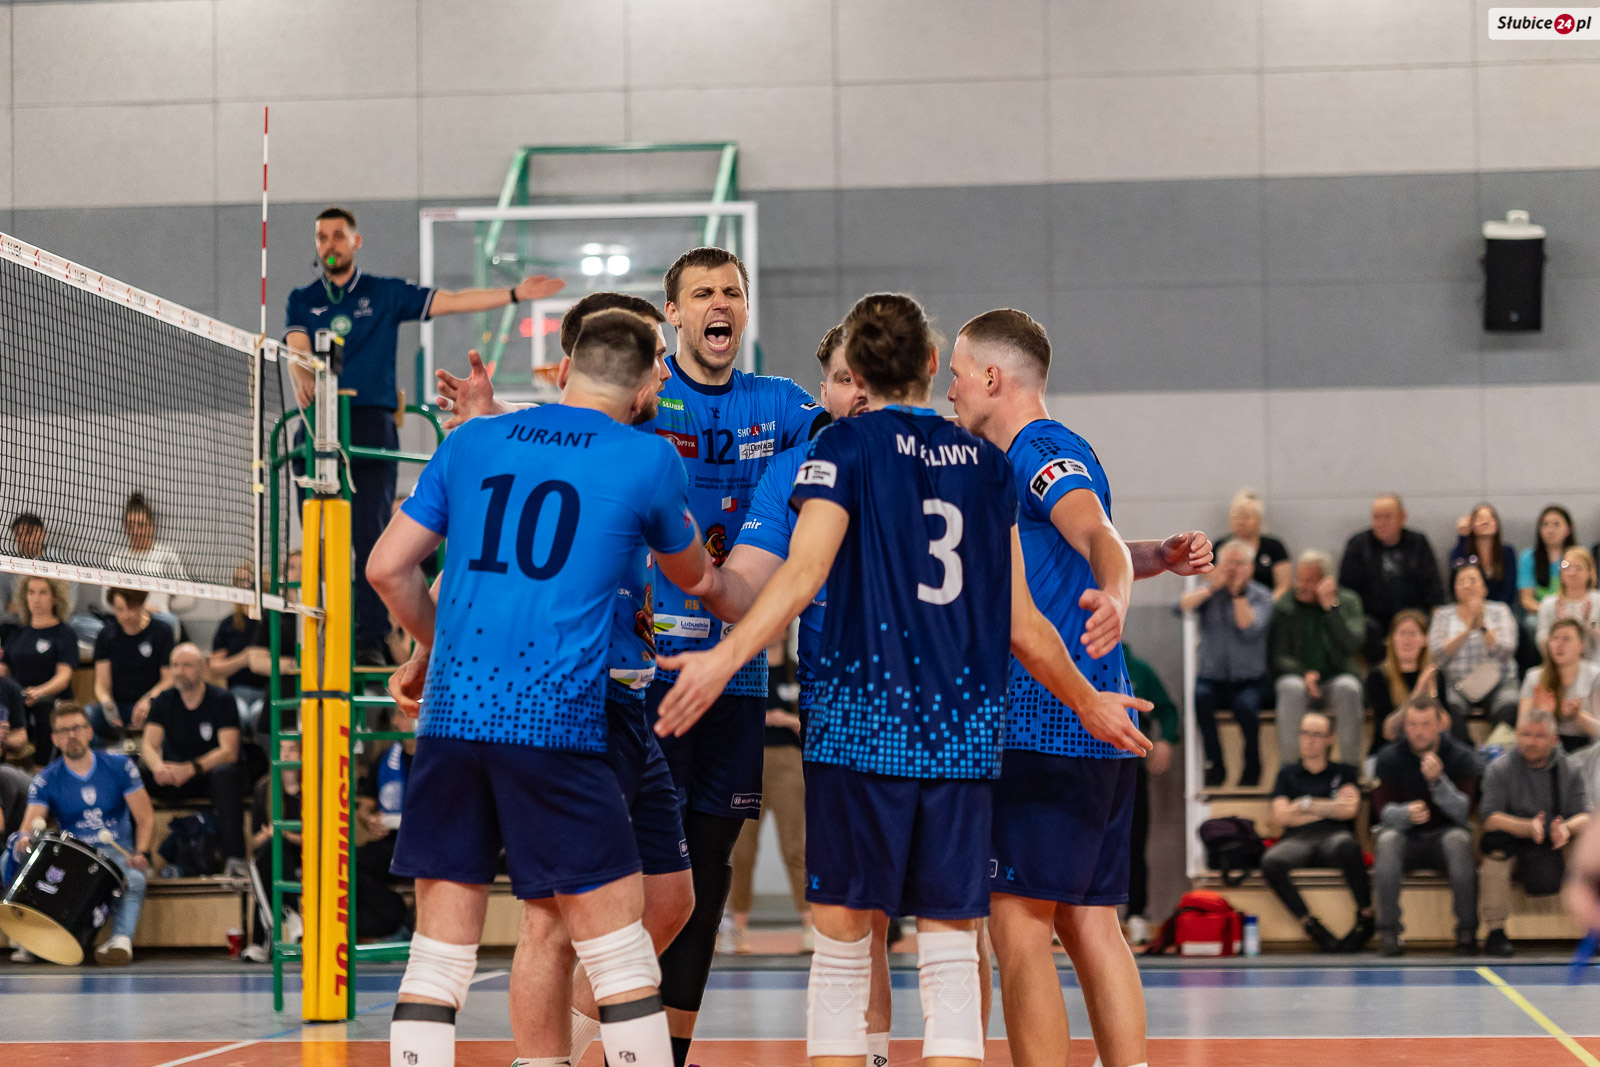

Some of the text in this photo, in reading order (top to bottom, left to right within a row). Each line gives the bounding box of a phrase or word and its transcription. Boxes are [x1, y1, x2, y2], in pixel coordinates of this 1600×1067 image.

[506, 424, 598, 449] JURANT
[702, 428, 736, 465] 12
[1031, 460, 1069, 497] BTT
[468, 473, 581, 581] 10
[917, 498, 964, 605] 3
